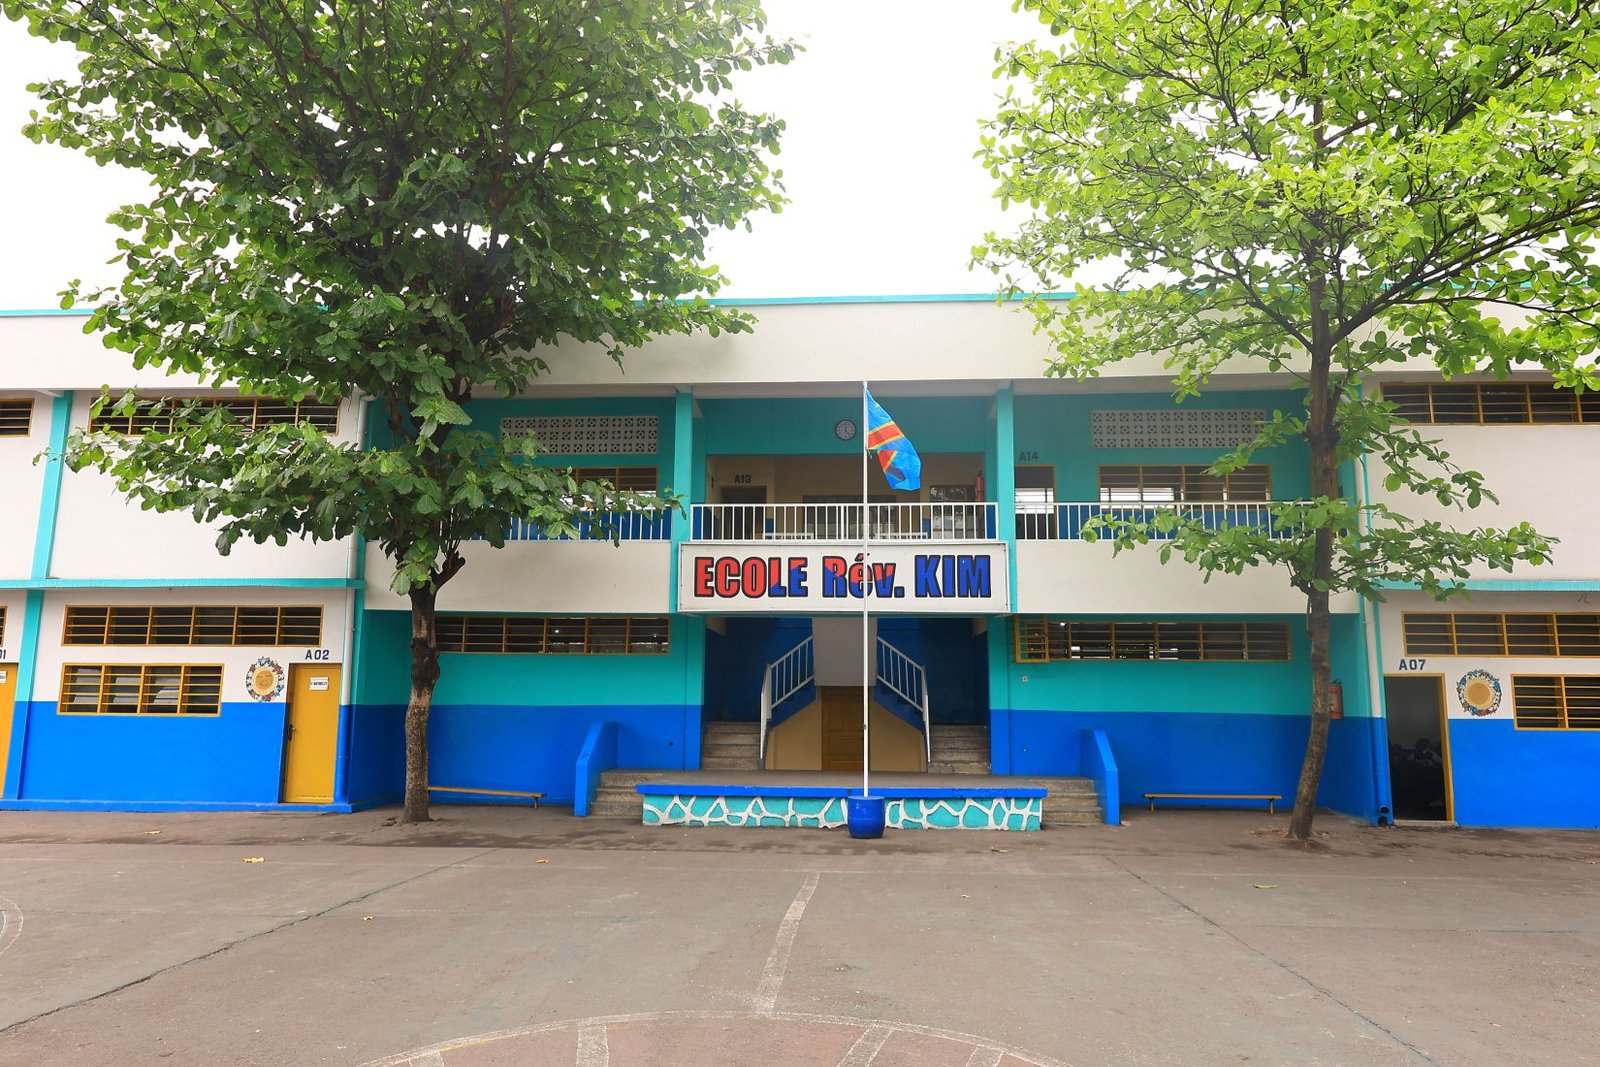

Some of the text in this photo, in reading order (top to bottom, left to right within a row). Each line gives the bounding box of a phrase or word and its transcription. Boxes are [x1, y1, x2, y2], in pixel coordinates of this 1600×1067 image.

[1019, 450, 1040, 461] A14
[734, 474, 752, 484] A13
[694, 552, 992, 599] ECOLE Rév. KIM
[305, 649, 330, 660] A02
[1399, 658, 1426, 671] A07
